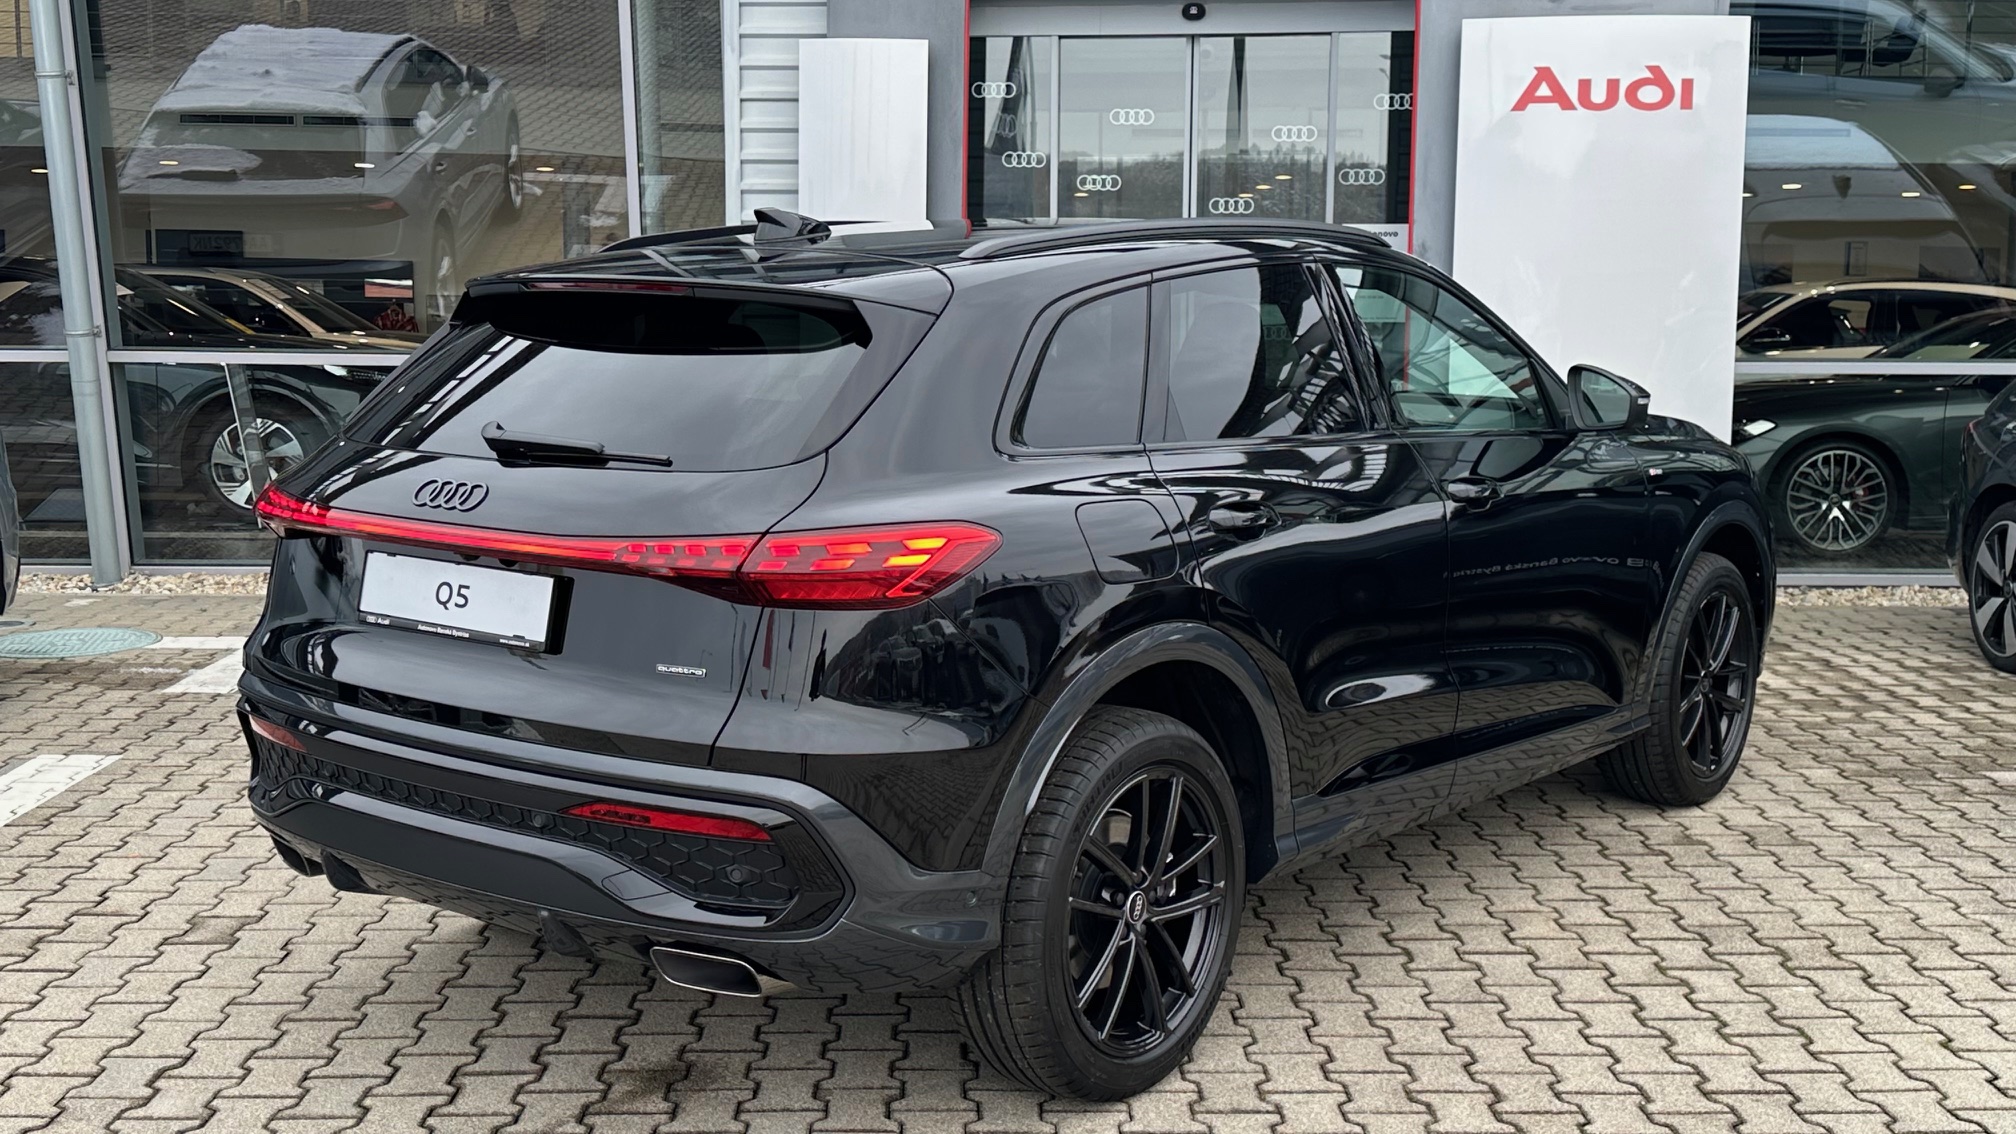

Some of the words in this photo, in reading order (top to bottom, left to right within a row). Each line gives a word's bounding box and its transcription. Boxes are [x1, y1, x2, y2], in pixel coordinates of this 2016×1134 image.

[1510, 65, 1694, 112] Audi
[435, 581, 470, 610] Q5
[657, 665, 703, 676] quattro
